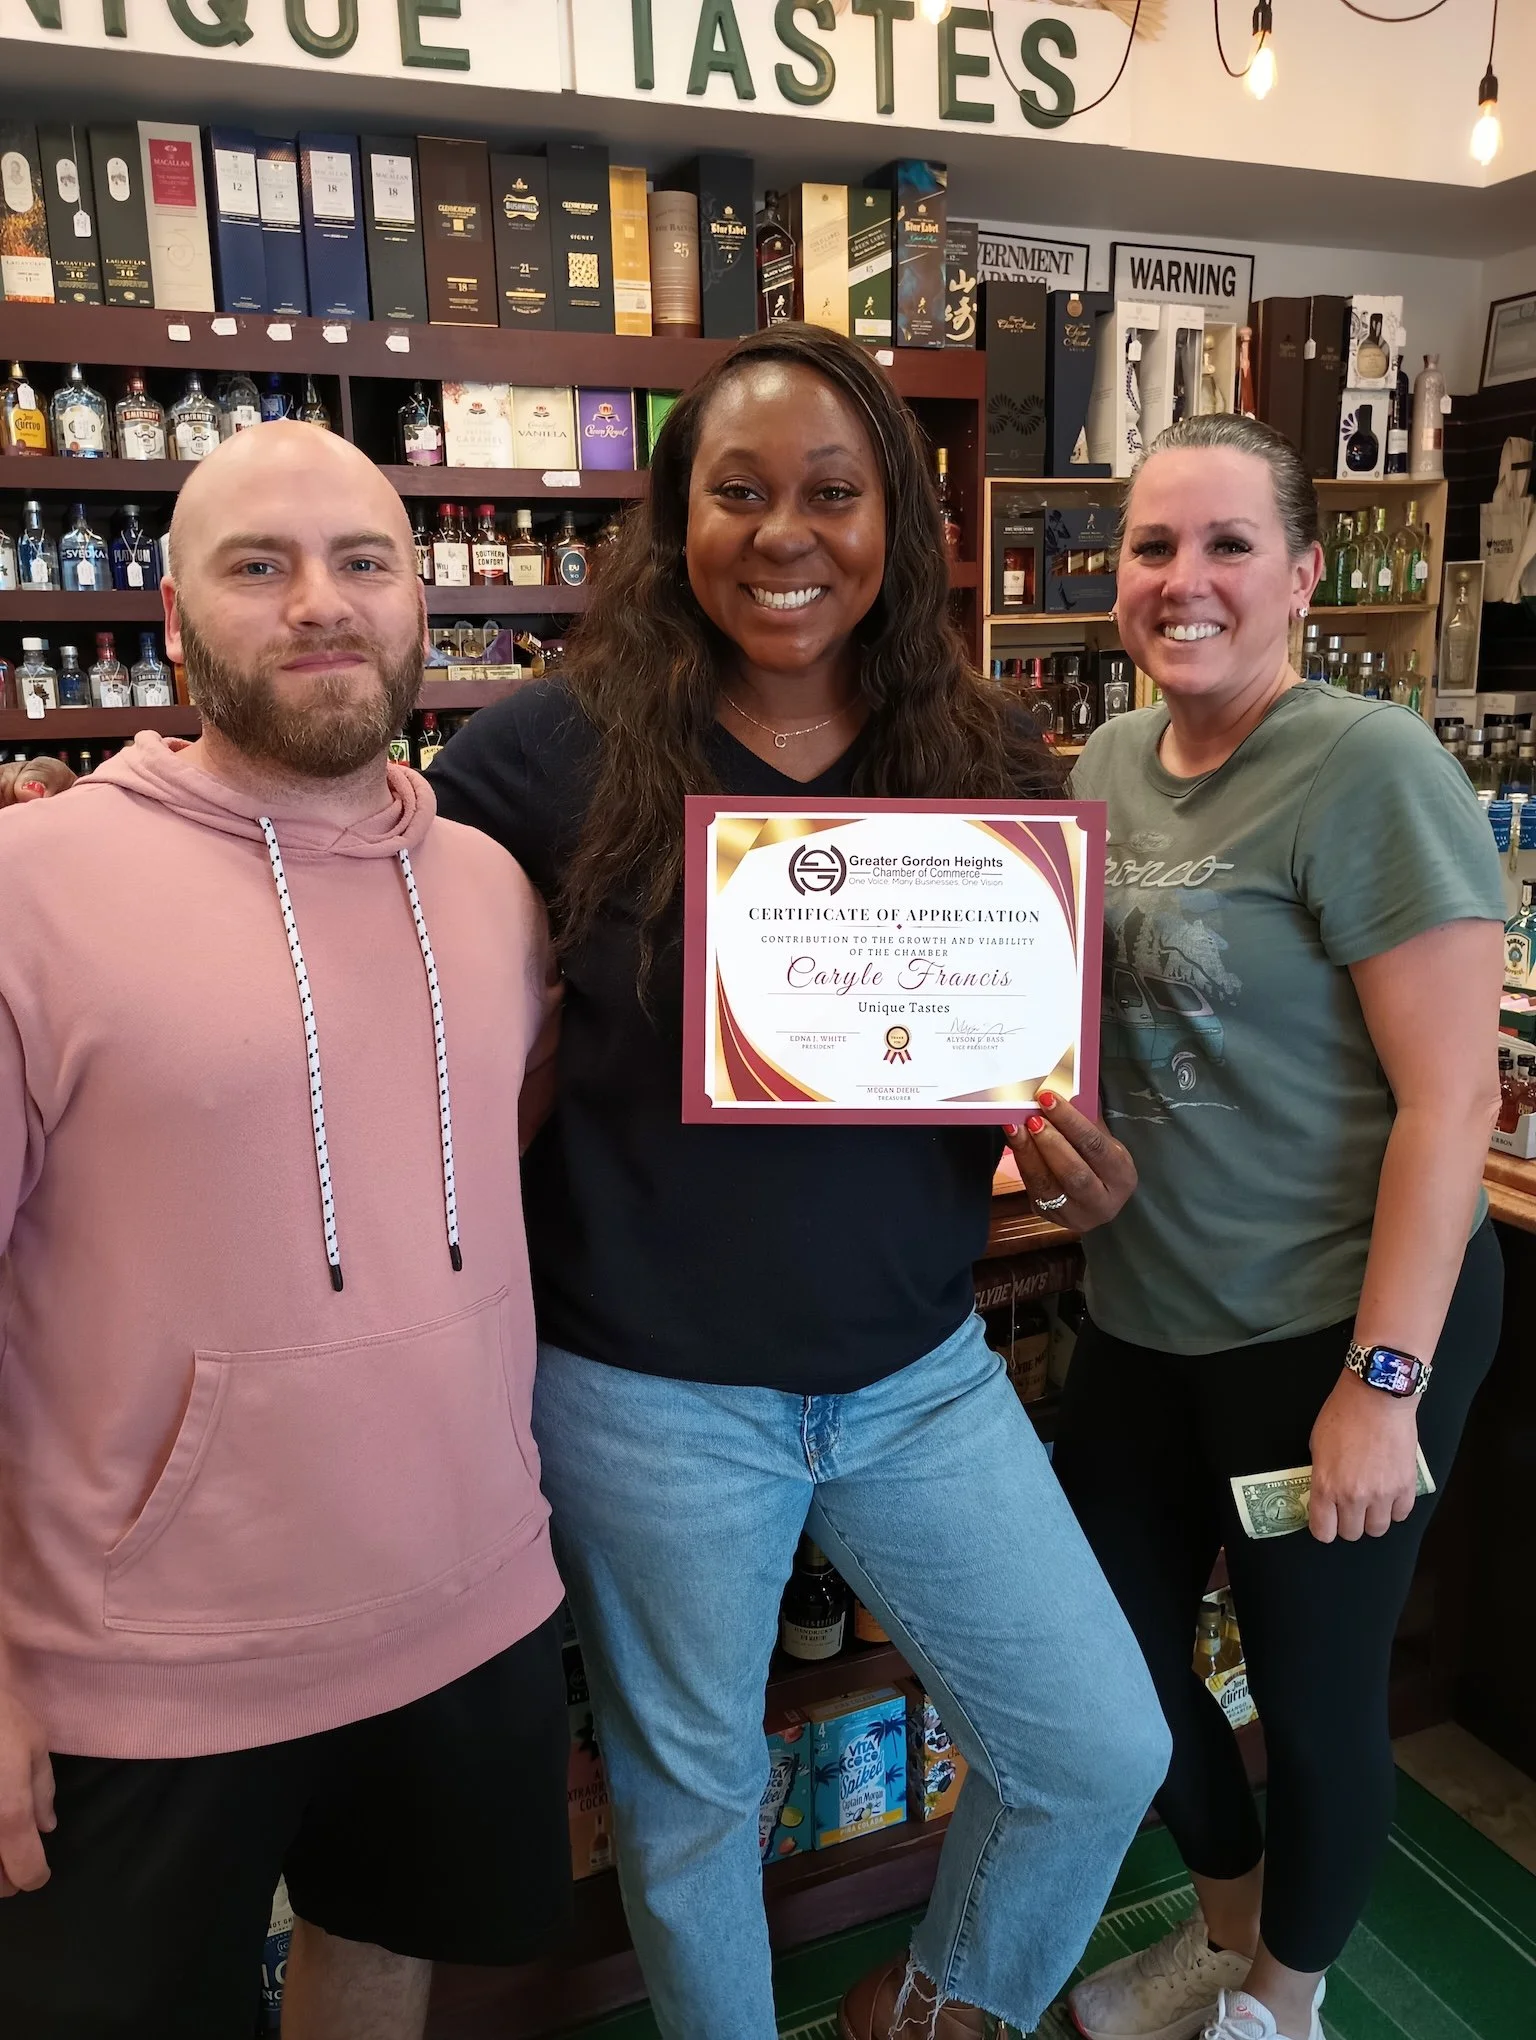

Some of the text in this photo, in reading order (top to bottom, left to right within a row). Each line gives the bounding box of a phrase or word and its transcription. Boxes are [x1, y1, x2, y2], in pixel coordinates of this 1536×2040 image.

[153, 159, 190, 167] MACALLAN
[375, 172, 409, 181] MACALLAN
[232, 182, 243, 191] 12
[327, 184, 338, 193] 18
[388, 187, 398, 196] 18
[505, 201, 538, 212] BUSHMILLS
[710, 222, 728, 234] Blue
[728, 224, 747, 236] Label
[904, 221, 939, 233] Blue Label
[851, 241, 870, 252] GREEN
[870, 232, 888, 244] LABEL
[673, 242, 690, 258] 25
[105, 258, 147, 266] LAGAVULIN
[979, 242, 1074, 275] ERNMENT
[120, 269, 134, 278] 16
[519, 263, 530, 273] 21
[70, 271, 84, 279] 16
[1130, 257, 1236, 297] WARNING
[458, 283, 468, 292] 18
[125, 411, 161, 420] SMIRNOFF
[179, 413, 215, 422] SMIRNOFF
[15, 418, 41, 431] Cuervo
[518, 430, 567, 438] VANILLA
[585, 424, 628, 438] Crown Royal
[66, 549, 105, 559] SVEDKA
[114, 549, 151, 562] PLATUM
[475, 551, 505, 559] SOUTHERN
[478, 558, 504, 566] COMFORT
[849, 855, 1003, 869] Greater Gordon Heights
[872, 867, 980, 878] Chamber of Commerce
[1104, 855, 1235, 888] ronco
[849, 877, 866, 885] One
[892, 878, 913, 886] Many
[962, 878, 979, 886] One
[749, 907, 1040, 923] CERTIFICATE OF APPRECIATION
[761, 935, 1035, 946] CONTRIBUTION TO THE GROWTH AND VIABILITY
[1506, 937, 1526, 947] BOMBAY
[849, 948, 949, 957] OF THE CHAMBER
[786, 956, 1013, 996] Caryle Francis
[858, 1001, 950, 1016] Unique Tastes
[1265, 1480, 1283, 1489] THE
[1220, 1686, 1248, 1709] Cuerv
[818, 1722, 826, 1738] 4
[848, 1740, 875, 1757] VITA
[848, 1750, 880, 1768] COCO
[840, 1758, 884, 1800] Spiked
[842, 1795, 863, 1811] Captain
[857, 1815, 884, 1831] COLADA
